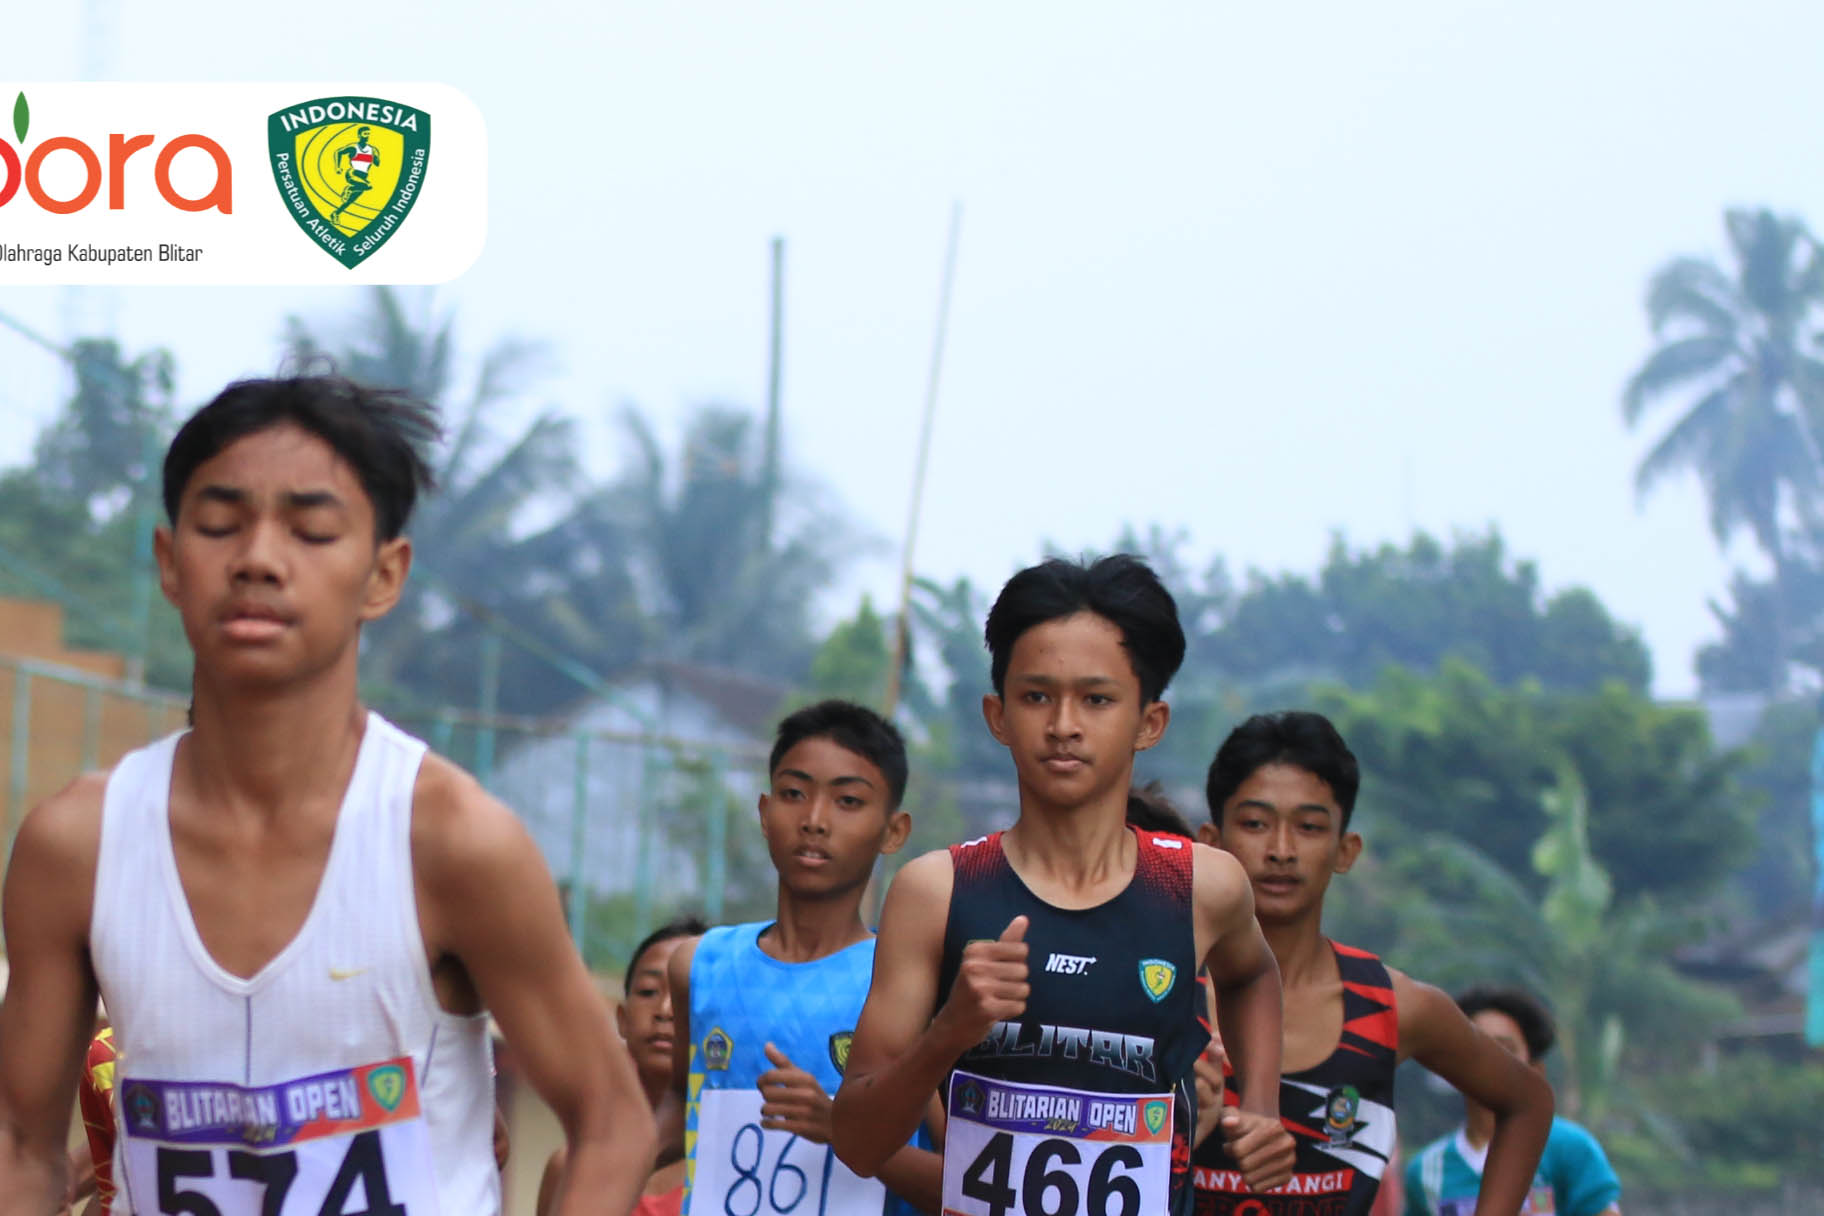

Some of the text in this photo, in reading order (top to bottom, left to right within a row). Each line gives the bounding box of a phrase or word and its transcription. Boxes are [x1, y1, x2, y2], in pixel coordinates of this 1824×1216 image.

[163, 1077, 361, 1132] BLITARIAN OPEN
[987, 1089, 1138, 1136] BLITARIAN OPEN
